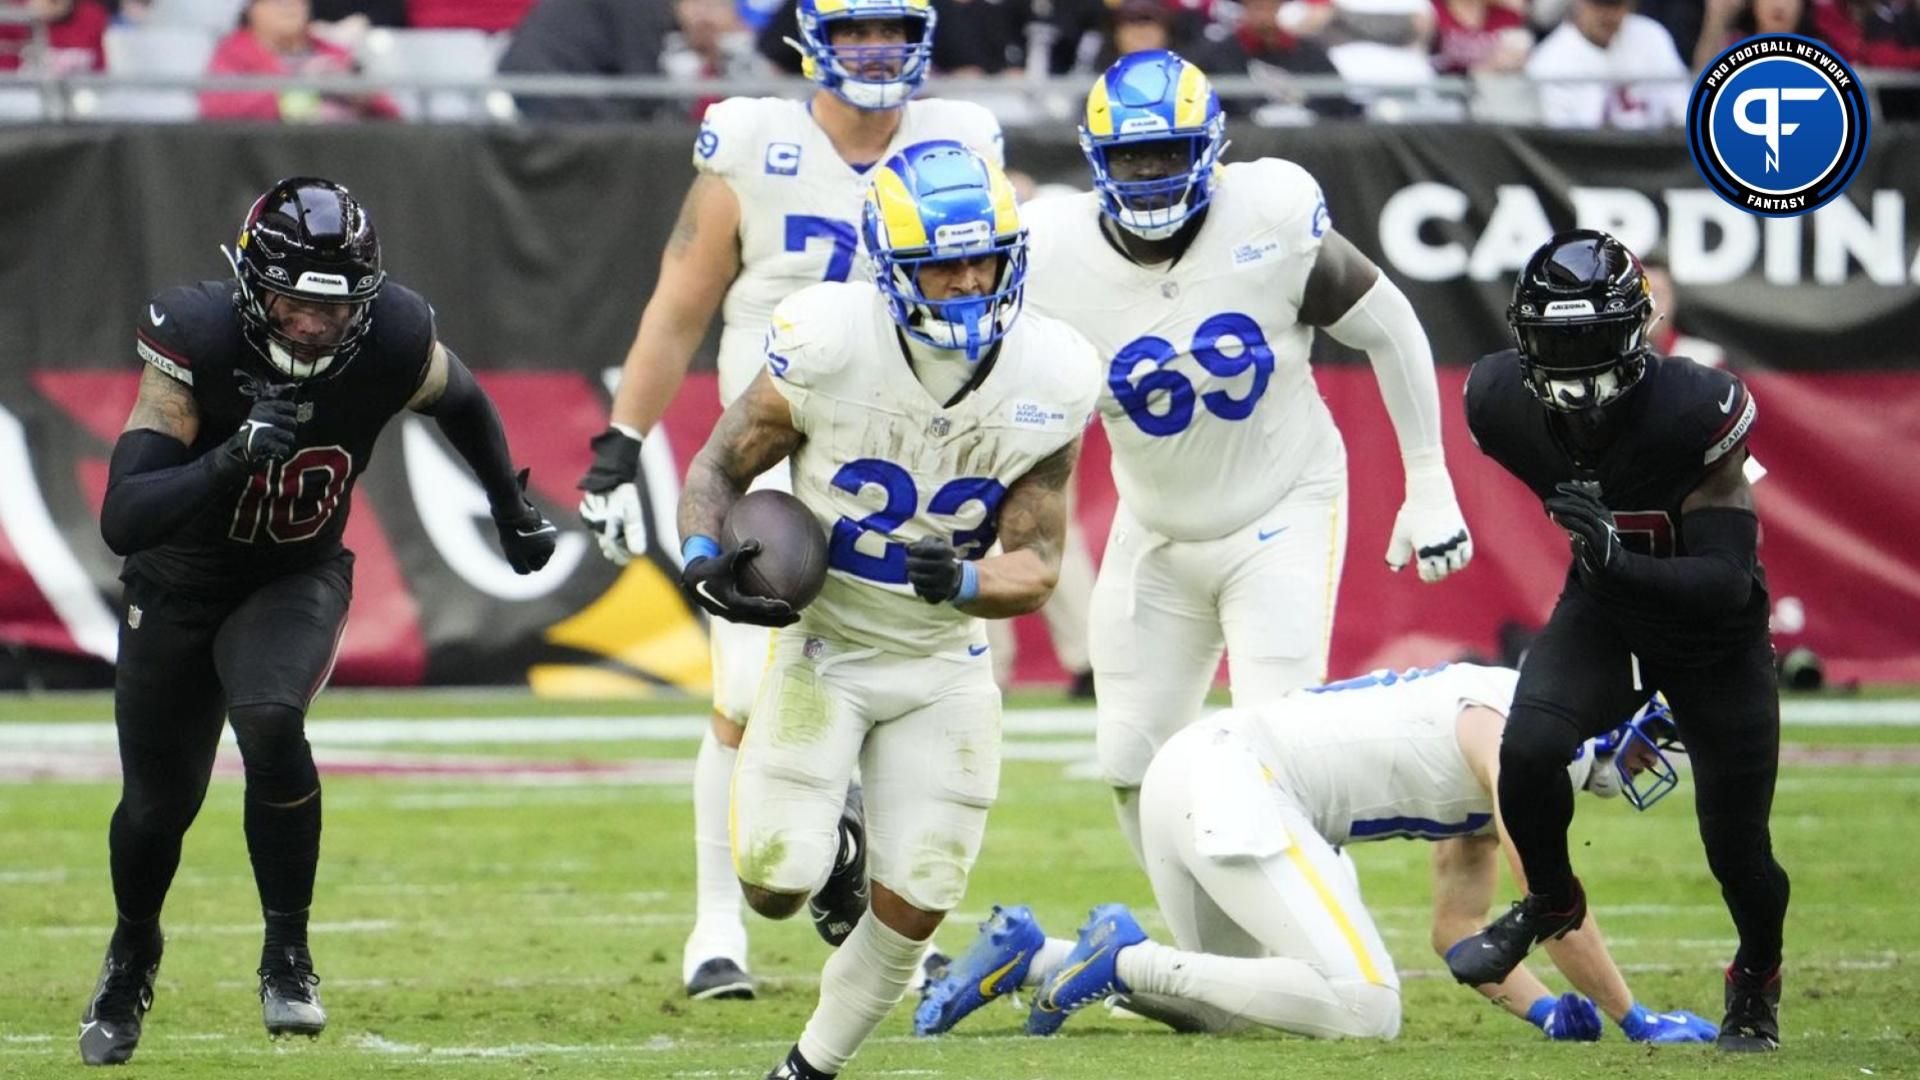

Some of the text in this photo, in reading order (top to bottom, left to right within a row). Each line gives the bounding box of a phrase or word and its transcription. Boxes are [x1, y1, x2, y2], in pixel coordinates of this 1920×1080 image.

[768, 144, 798, 168] C
[784, 214, 858, 283] 7
[1378, 181, 1920, 285] CARDIN
[307, 275, 343, 285] ARIZONA
[1551, 303, 1587, 311] ARIZONA
[1107, 312, 1275, 437] 69
[227, 445, 352, 544] 10
[828, 458, 1007, 586] 23
